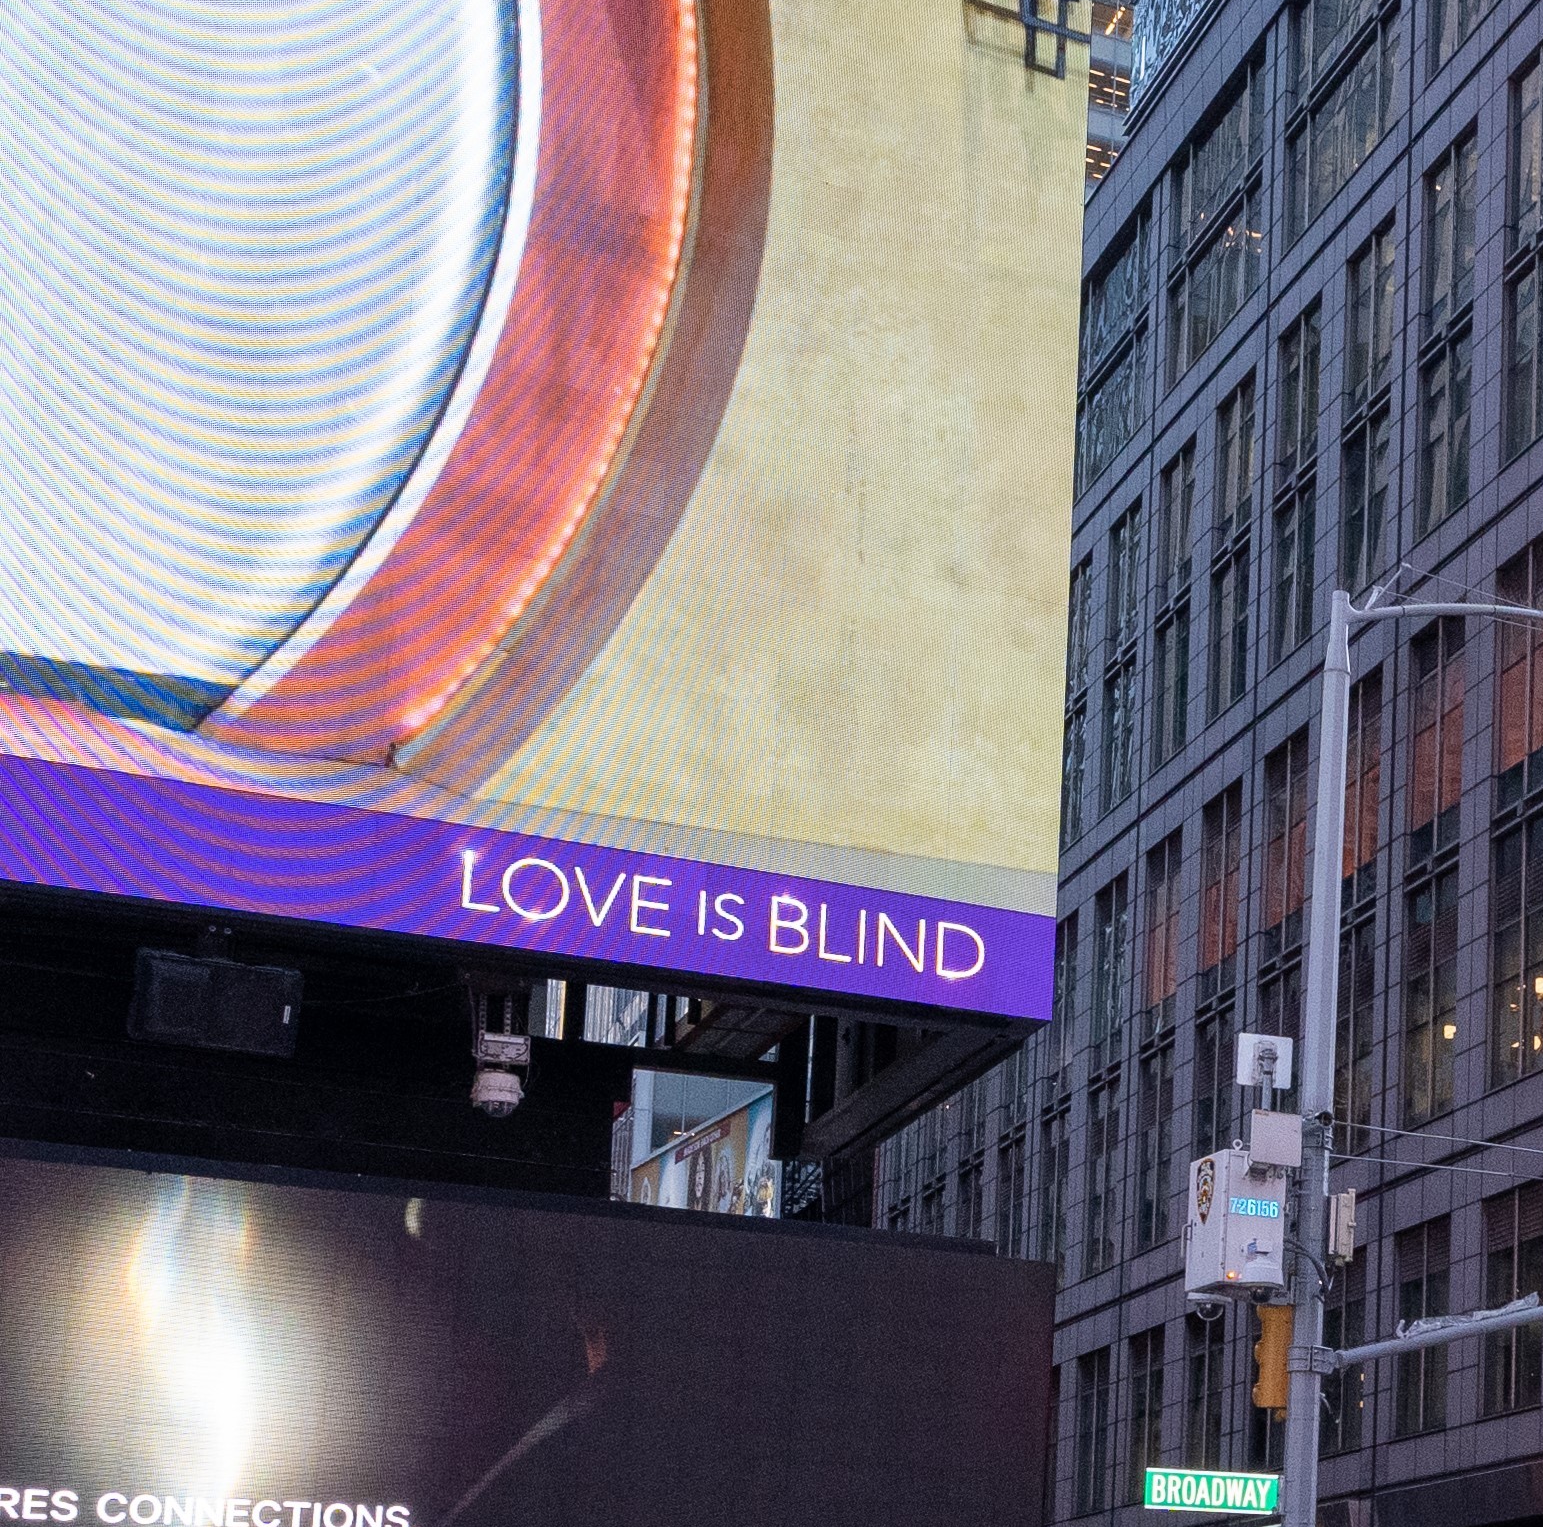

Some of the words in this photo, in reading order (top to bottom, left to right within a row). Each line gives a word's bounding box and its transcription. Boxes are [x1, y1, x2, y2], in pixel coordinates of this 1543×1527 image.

[459, 850, 672, 939] LOVE
[768, 896, 985, 980] BLIND
[1152, 1474, 1271, 1508] BROADWAY
